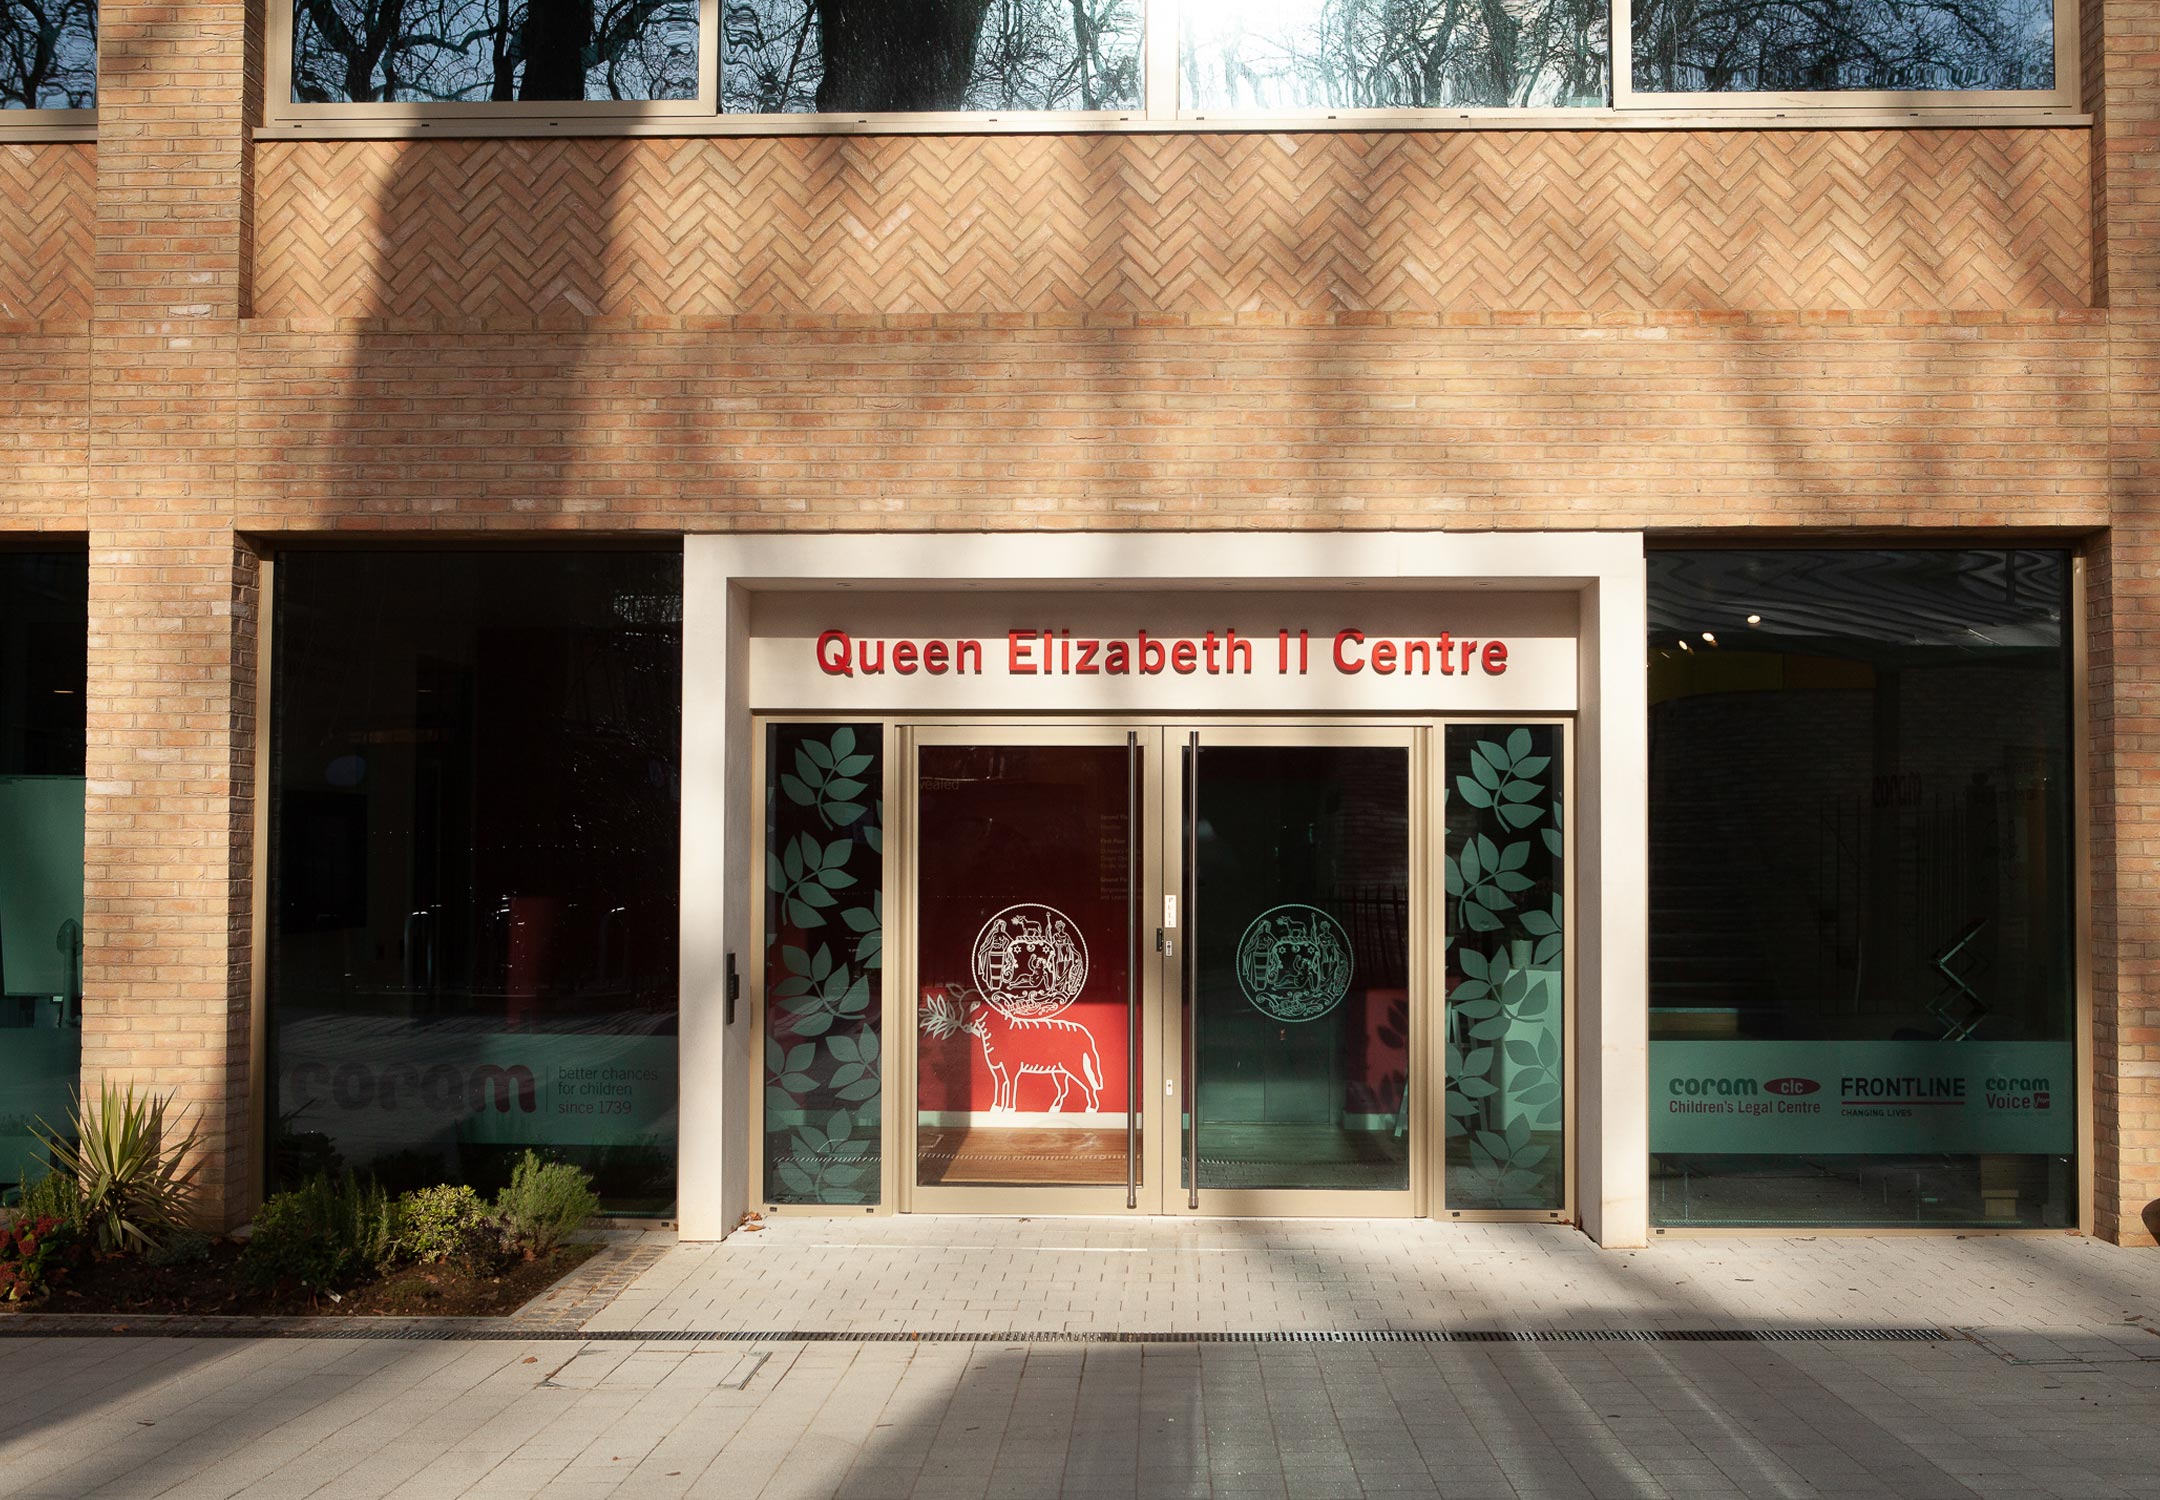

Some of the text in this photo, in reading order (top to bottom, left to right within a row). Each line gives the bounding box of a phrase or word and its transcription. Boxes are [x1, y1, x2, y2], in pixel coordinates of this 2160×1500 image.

[816, 627, 1509, 677] Queen Elizabeth II Centre
[558, 1066, 659, 1081] better chances
[289, 1063, 537, 1114] coram
[558, 1082, 633, 1097] for children
[1669, 1078, 1804, 1096] coram clc
[1841, 1077, 1966, 1097] FRONTLINE
[1985, 1078, 2050, 1091] coram
[558, 1100, 632, 1115] since 1739
[1669, 1100, 1821, 1116] Children's Legal Centre
[1986, 1093, 2031, 1109] Voice
[1841, 1109, 1913, 1117] CHANGING LIVES
